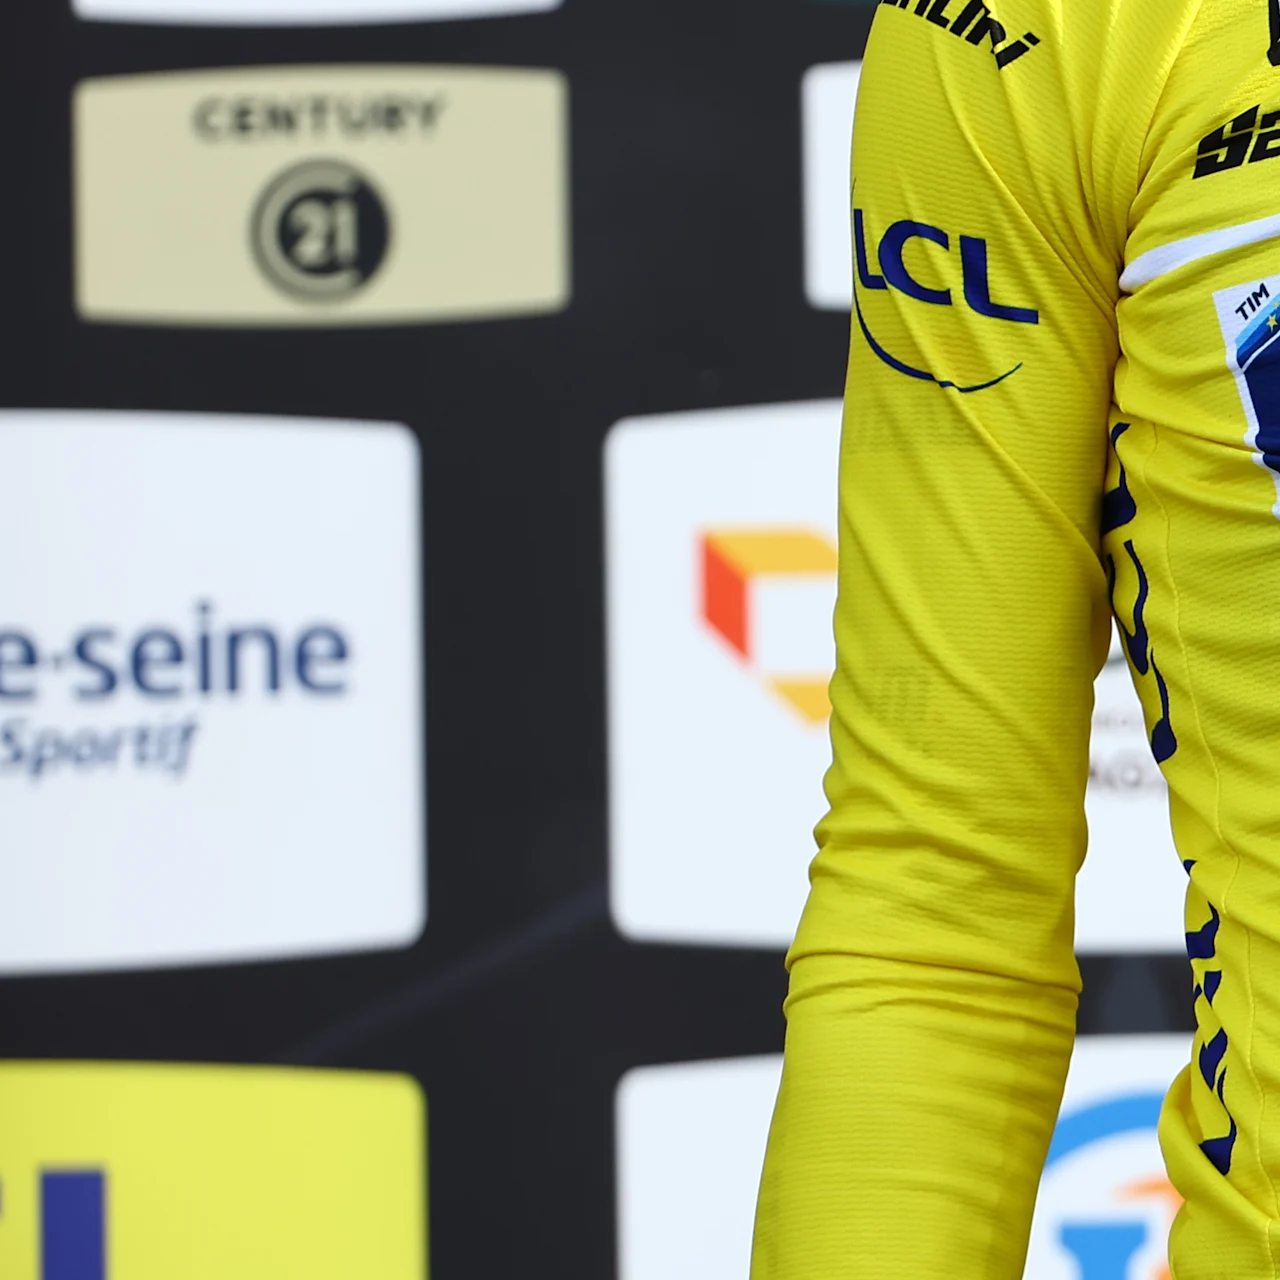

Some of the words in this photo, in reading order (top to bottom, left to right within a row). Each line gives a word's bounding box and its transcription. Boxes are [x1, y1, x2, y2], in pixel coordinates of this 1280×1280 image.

[192, 94, 446, 144] CENTURY
[853, 208, 1039, 324] LCL
[1235, 282, 1270, 321] TIM
